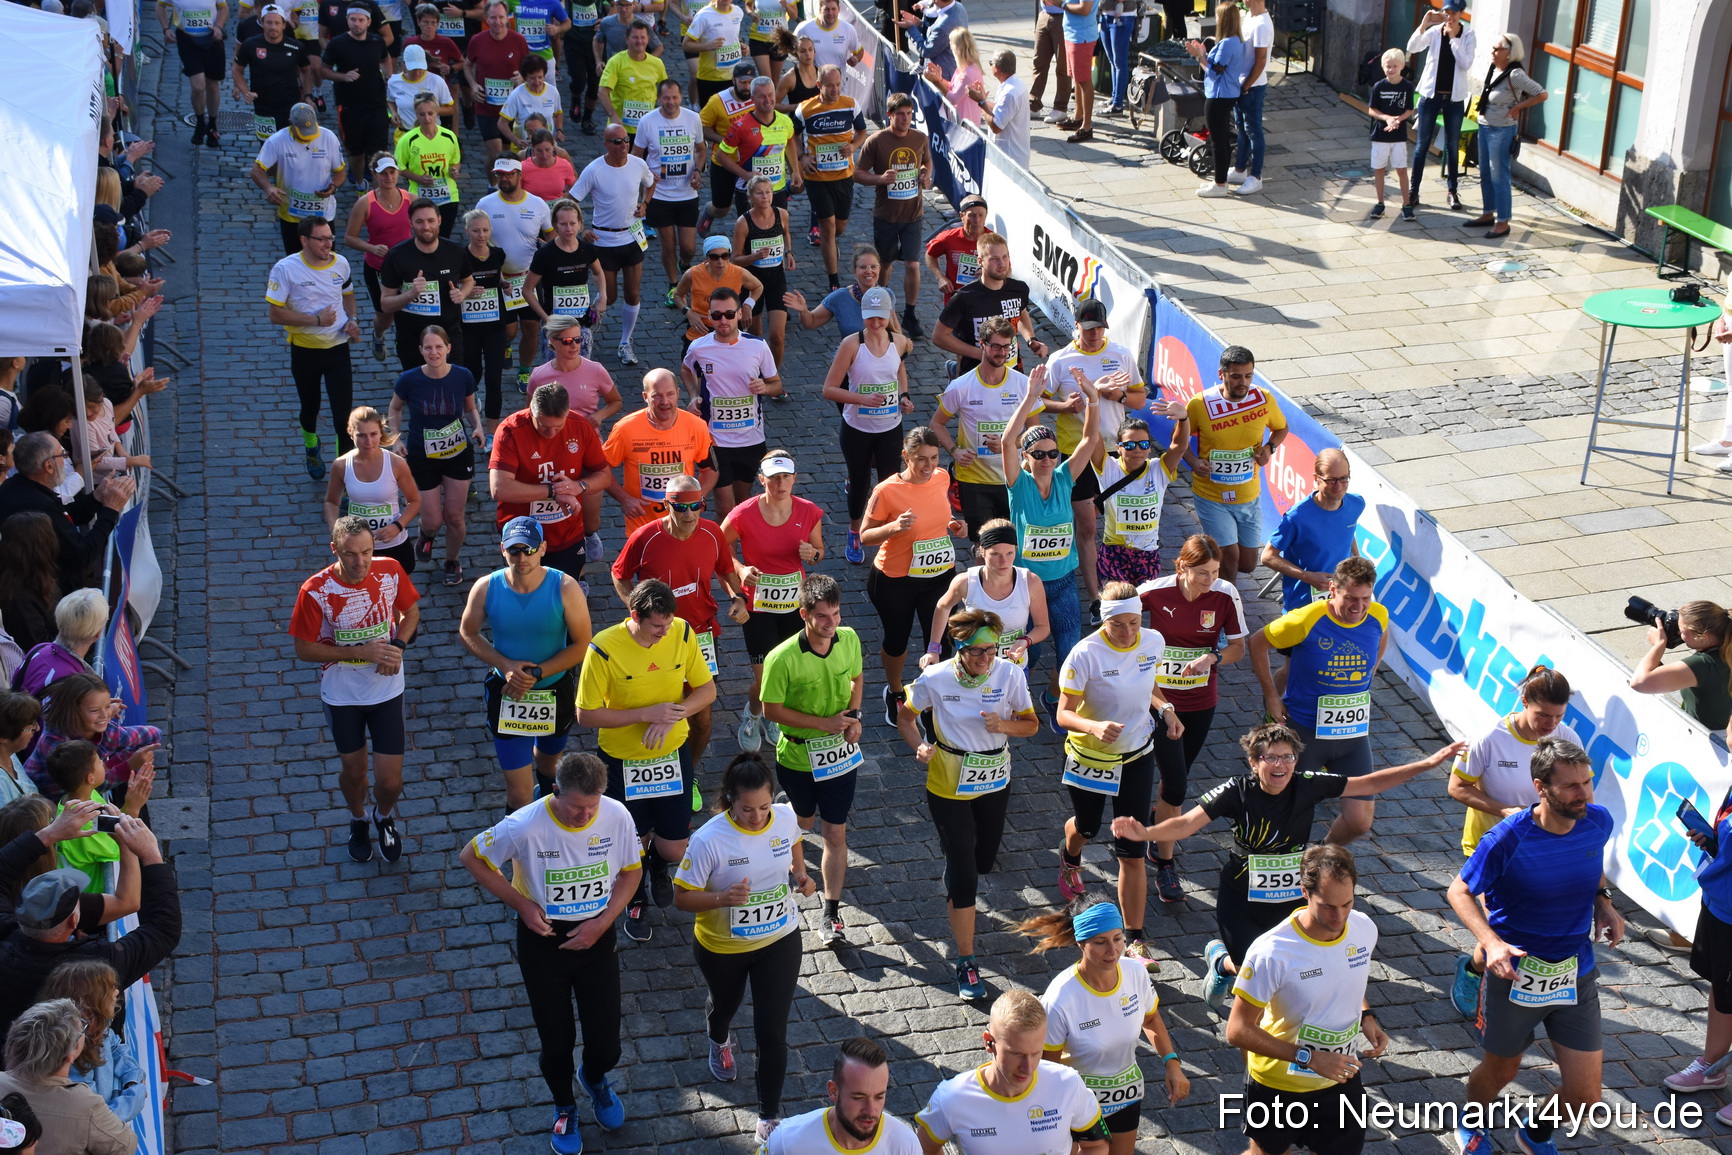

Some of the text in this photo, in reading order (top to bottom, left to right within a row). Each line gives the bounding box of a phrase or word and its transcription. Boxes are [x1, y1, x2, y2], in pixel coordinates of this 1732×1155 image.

[521, 5, 548, 15] Freitag
[575, 12, 595, 20] 2105
[186, 19, 209, 27] 2824
[521, 27, 542, 35] 2132
[720, 51, 740, 61] 2780
[488, 87, 510, 96] 2271
[819, 117, 846, 127] Fischer
[663, 145, 688, 155] 2589
[420, 152, 446, 161] Müller
[891, 180, 915, 191] 2003
[420, 188, 446, 198] 2334
[293, 200, 321, 211] 2225
[754, 239, 784, 249] BOCK
[554, 286, 588, 295] BOCK
[465, 300, 495, 311] 2028
[557, 297, 587, 307] 2027
[1000, 298, 1022, 309] ROTH
[1003, 308, 1021, 319] 2015
[861, 384, 896, 393] BOCK
[714, 397, 751, 407] BOCK
[716, 407, 751, 421] 2333
[1211, 407, 1269, 432] MAX BÖGL
[721, 421, 747, 429] TOBIAS
[982, 423, 1008, 431] BOC
[426, 424, 461, 440] BOCK
[430, 434, 462, 452] 1244
[439, 448, 458, 458] ANNA
[650, 450, 682, 465] RUN
[1212, 450, 1253, 460] BOCK
[643, 465, 680, 474] BOCK
[1214, 461, 1250, 474] 2375
[1221, 474, 1245, 482] OVIDIU
[644, 477, 671, 490] 283
[1119, 496, 1156, 505] BOCK
[350, 506, 388, 516] BOCK
[1122, 507, 1156, 522] 1166
[1028, 526, 1070, 535] BOCK
[1126, 523, 1153, 531] RENATA
[917, 540, 947, 551] BOCK
[1030, 538, 1066, 550] 1061
[918, 550, 950, 566] 1062
[1031, 550, 1062, 558] DANIELA
[761, 576, 799, 585] BOCK
[762, 587, 799, 600] 1077
[339, 626, 384, 639] BOCK
[1163, 649, 1204, 659] BOCK
[1166, 678, 1197, 686] SABINE
[1324, 694, 1366, 706] BOCK
[508, 704, 550, 721] 1249
[1323, 708, 1365, 725] 2490
[504, 721, 549, 731] WOLFGANG
[1330, 726, 1357, 734] PETER
[811, 735, 844, 750] BOC
[816, 743, 856, 767] 2040
[826, 760, 853, 775] ANDRE
[630, 764, 675, 784] 2059
[966, 767, 1006, 783] 2415
[636, 784, 672, 794] MARCEL
[973, 783, 995, 791] ROSA
[588, 836, 600, 846] 20
[770, 838, 781, 847] 20
[587, 843, 614, 851] Neumarkter
[587, 849, 610, 857] Stadtlauf
[728, 857, 750, 866] BOCK
[551, 867, 603, 882] BOCK
[552, 881, 604, 902] 2173
[1265, 890, 1296, 899] MARIA
[558, 902, 599, 914] ROLAND
[738, 902, 785, 924] 2172
[743, 922, 781, 935] TAMARA
[1347, 947, 1358, 956] 20
[1526, 958, 1574, 975] BOCK
[1300, 968, 1324, 979] BOCK
[1520, 974, 1570, 992] 2164
[1516, 989, 1570, 1003] BERNHARD
[1119, 997, 1130, 1006] 20
[1079, 1018, 1101, 1030] BOCK
[1305, 1026, 1356, 1043] BOCK
[1085, 1068, 1138, 1086] BOCK
[1093, 1085, 1138, 1104] 200
[1029, 1109, 1044, 1118] 20
[1030, 1115, 1063, 1126] Neumarkter
[970, 1127, 998, 1135] BOCK
[1031, 1123, 1058, 1133] Stadtlauf
